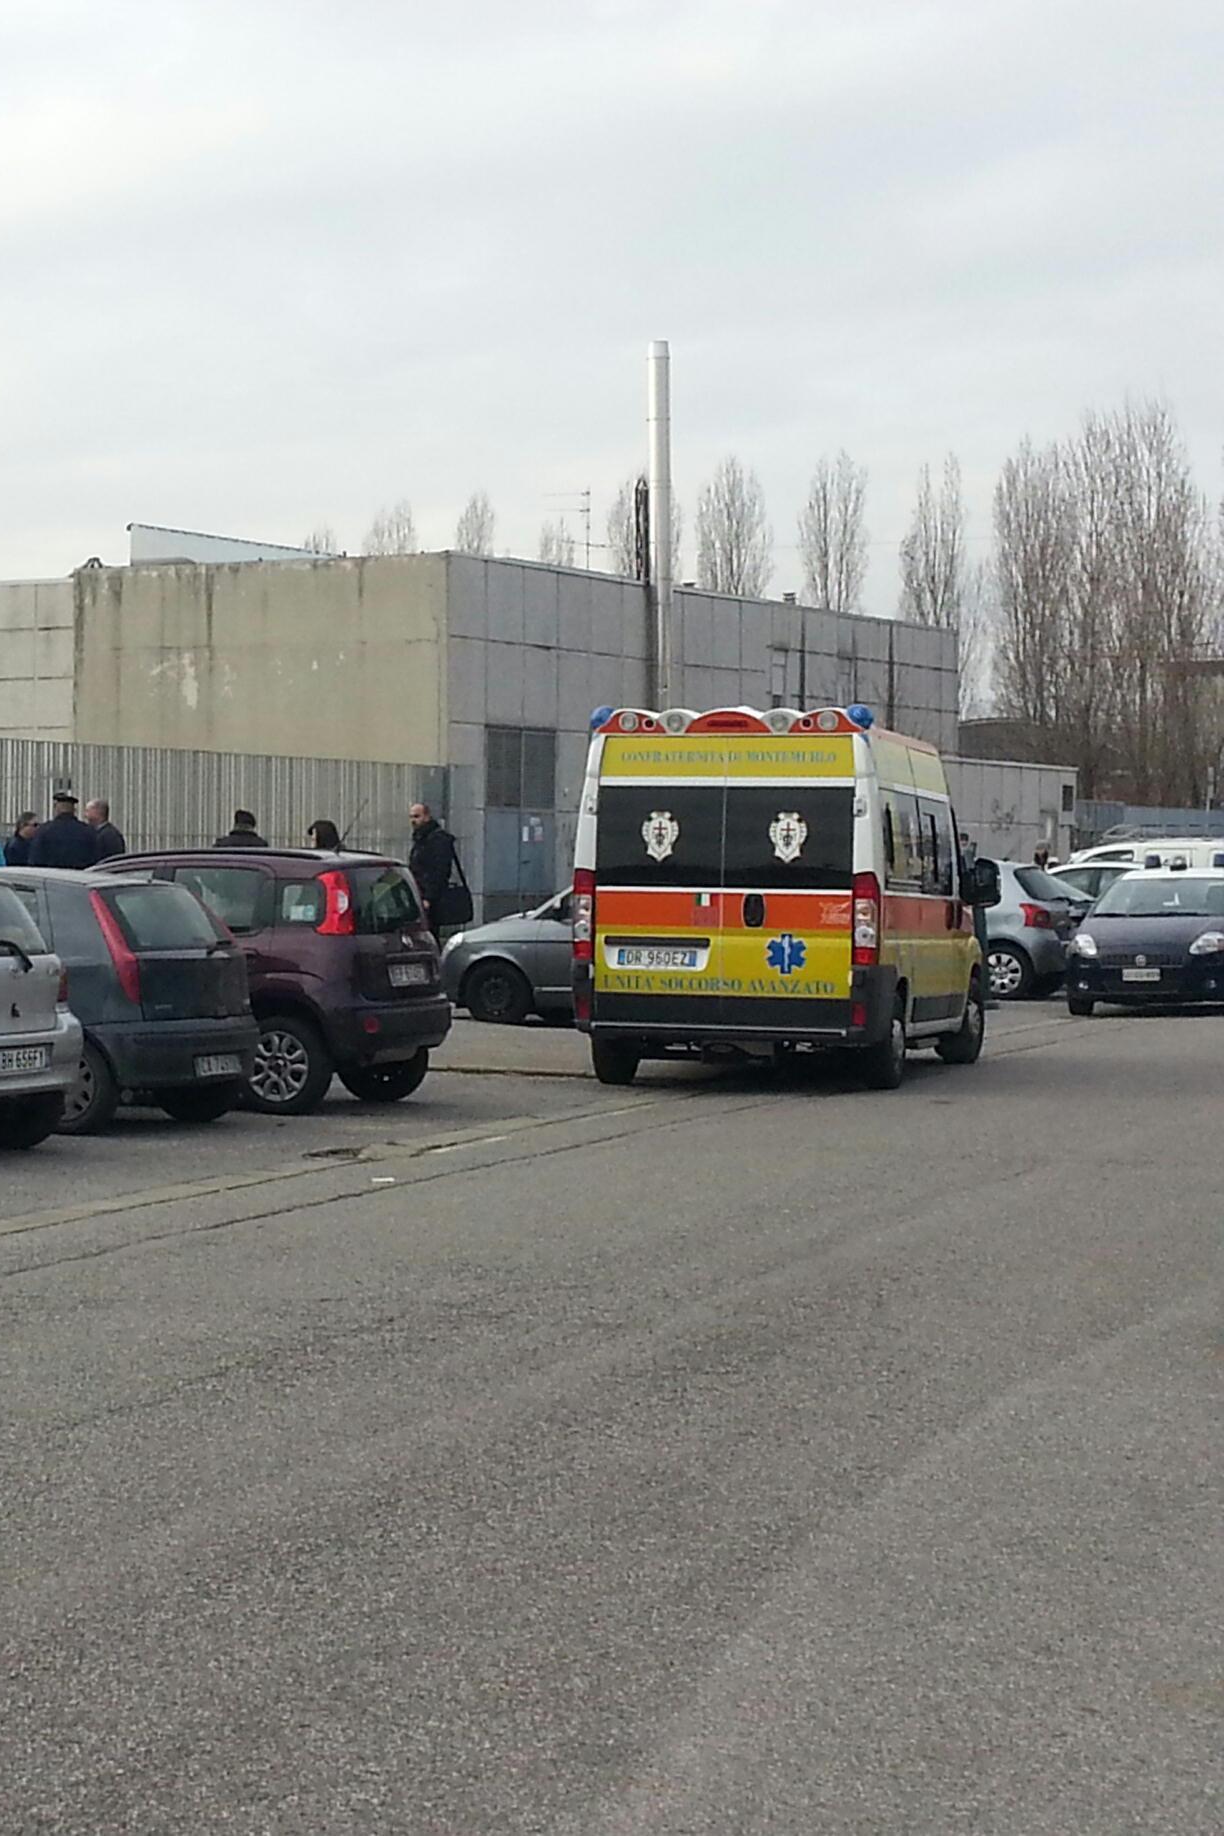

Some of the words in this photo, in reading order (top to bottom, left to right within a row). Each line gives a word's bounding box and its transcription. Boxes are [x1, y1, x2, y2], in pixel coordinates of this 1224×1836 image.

[626, 949, 643, 965] DR
[647, 950, 688, 966] 960EZ
[660, 977, 743, 993] SOCCORSO
[749, 978, 835, 995] AVANZATO
